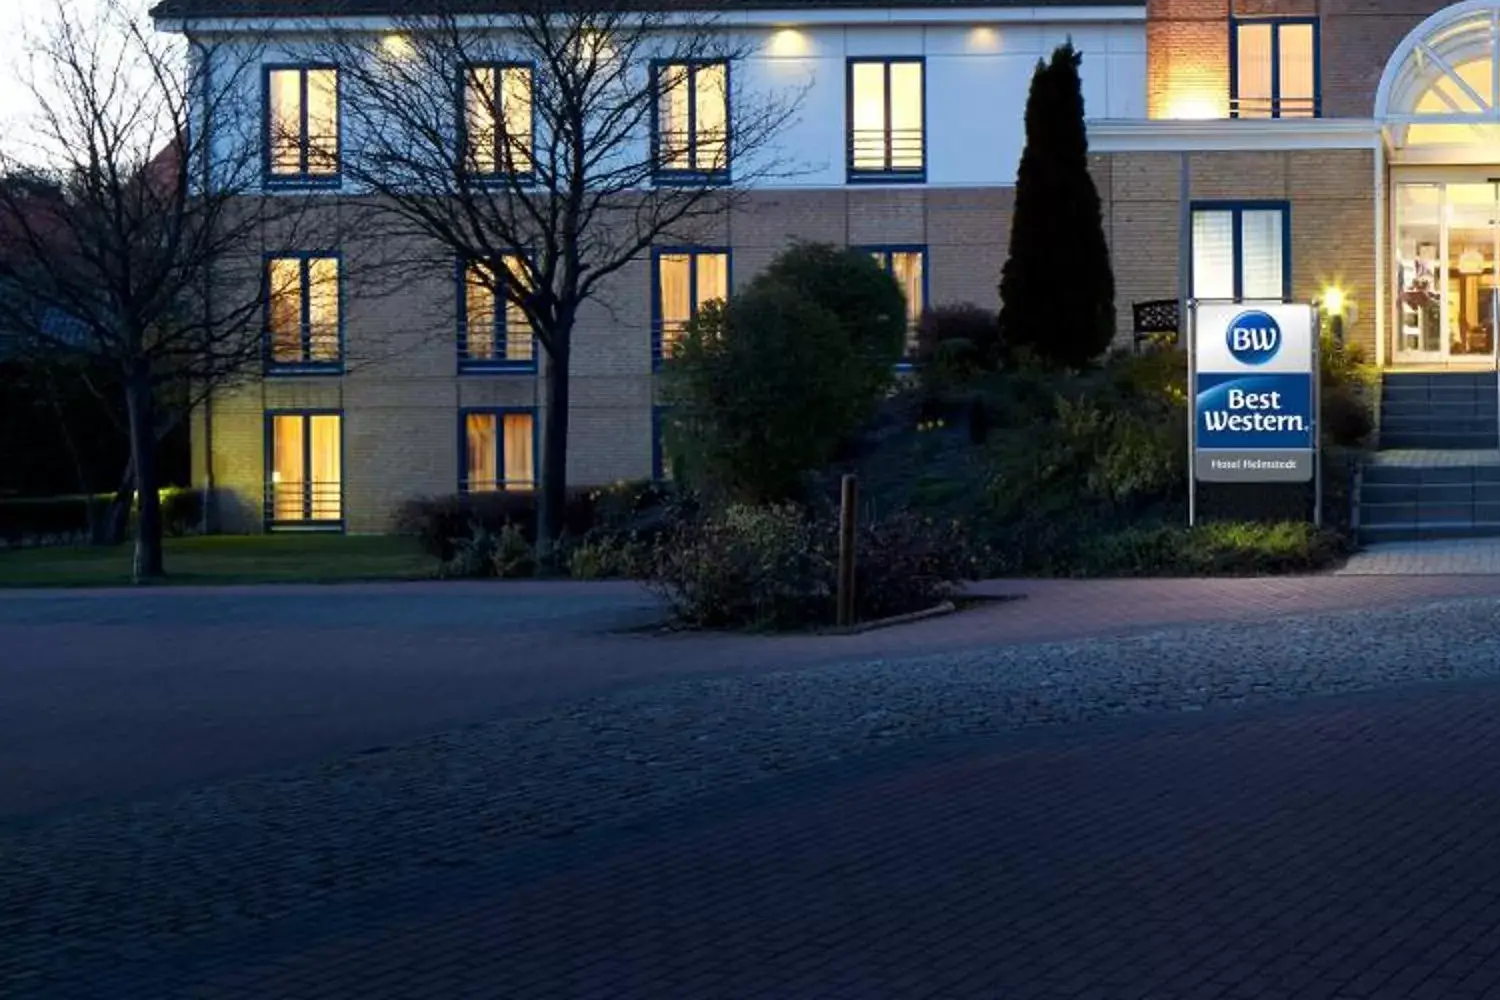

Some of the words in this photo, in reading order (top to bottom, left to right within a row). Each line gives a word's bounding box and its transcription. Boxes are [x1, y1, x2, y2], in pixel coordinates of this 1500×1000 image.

[1233, 328, 1276, 351] BW
[1228, 389, 1281, 409] Best
[1204, 411, 1302, 431] Western
